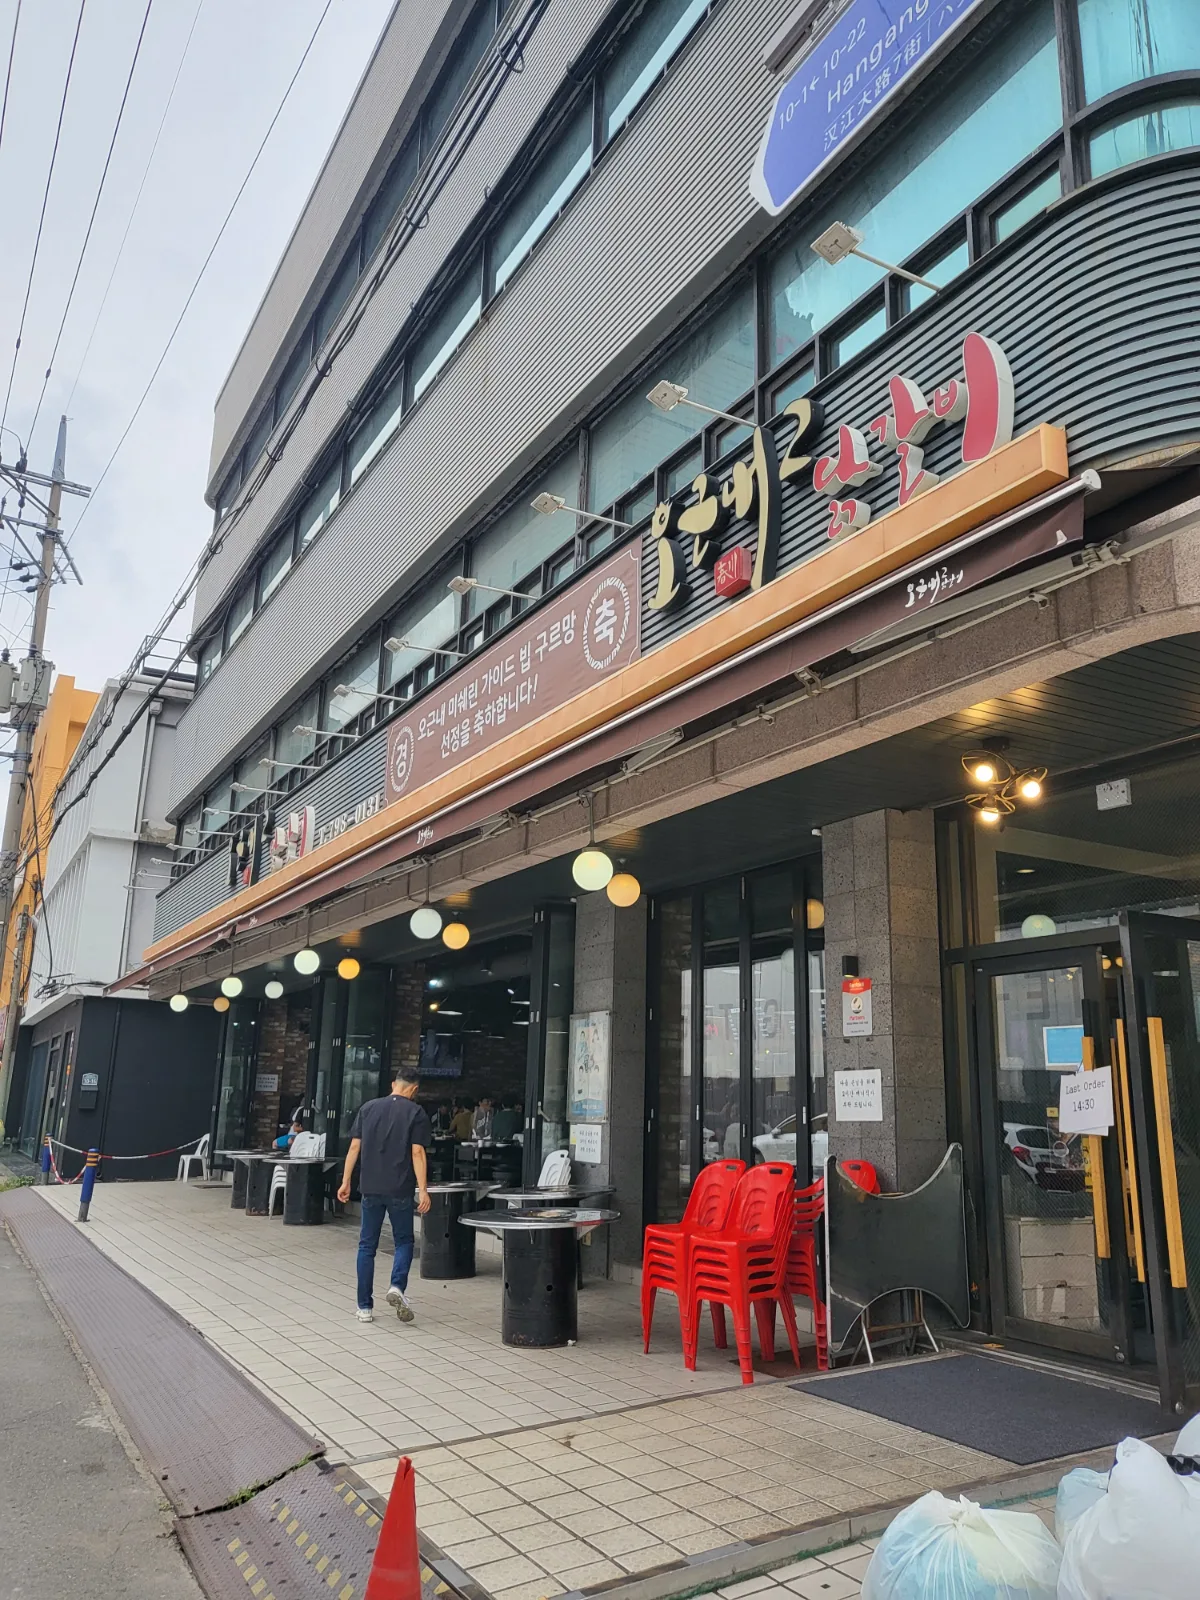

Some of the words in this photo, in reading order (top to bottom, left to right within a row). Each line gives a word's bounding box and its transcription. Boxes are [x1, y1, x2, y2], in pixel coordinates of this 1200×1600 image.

[779, 86, 807, 130] 10-1
[822, 17, 867, 78] 10-22
[827, 0, 929, 113] Hangang
[812, 331, 1014, 541] 닭갈비
[716, 550, 738, 585] 春川
[593, 597, 618, 645] 축
[417, 701, 446, 741] 오근내
[448, 678, 478, 718] 미쉐린
[481, 653, 516, 695] 가이드
[519, 640, 531, 675] 빕
[534, 609, 577, 662] 구르망
[441, 717, 471, 759] 선정을
[473, 673, 538, 736] 축하합니다!
[396, 738, 408, 778] 경
[1065, 1081, 1081, 1095] Last
[1083, 1079, 1106, 1091] Order
[1072, 1098, 1095, 1113] 14:30
